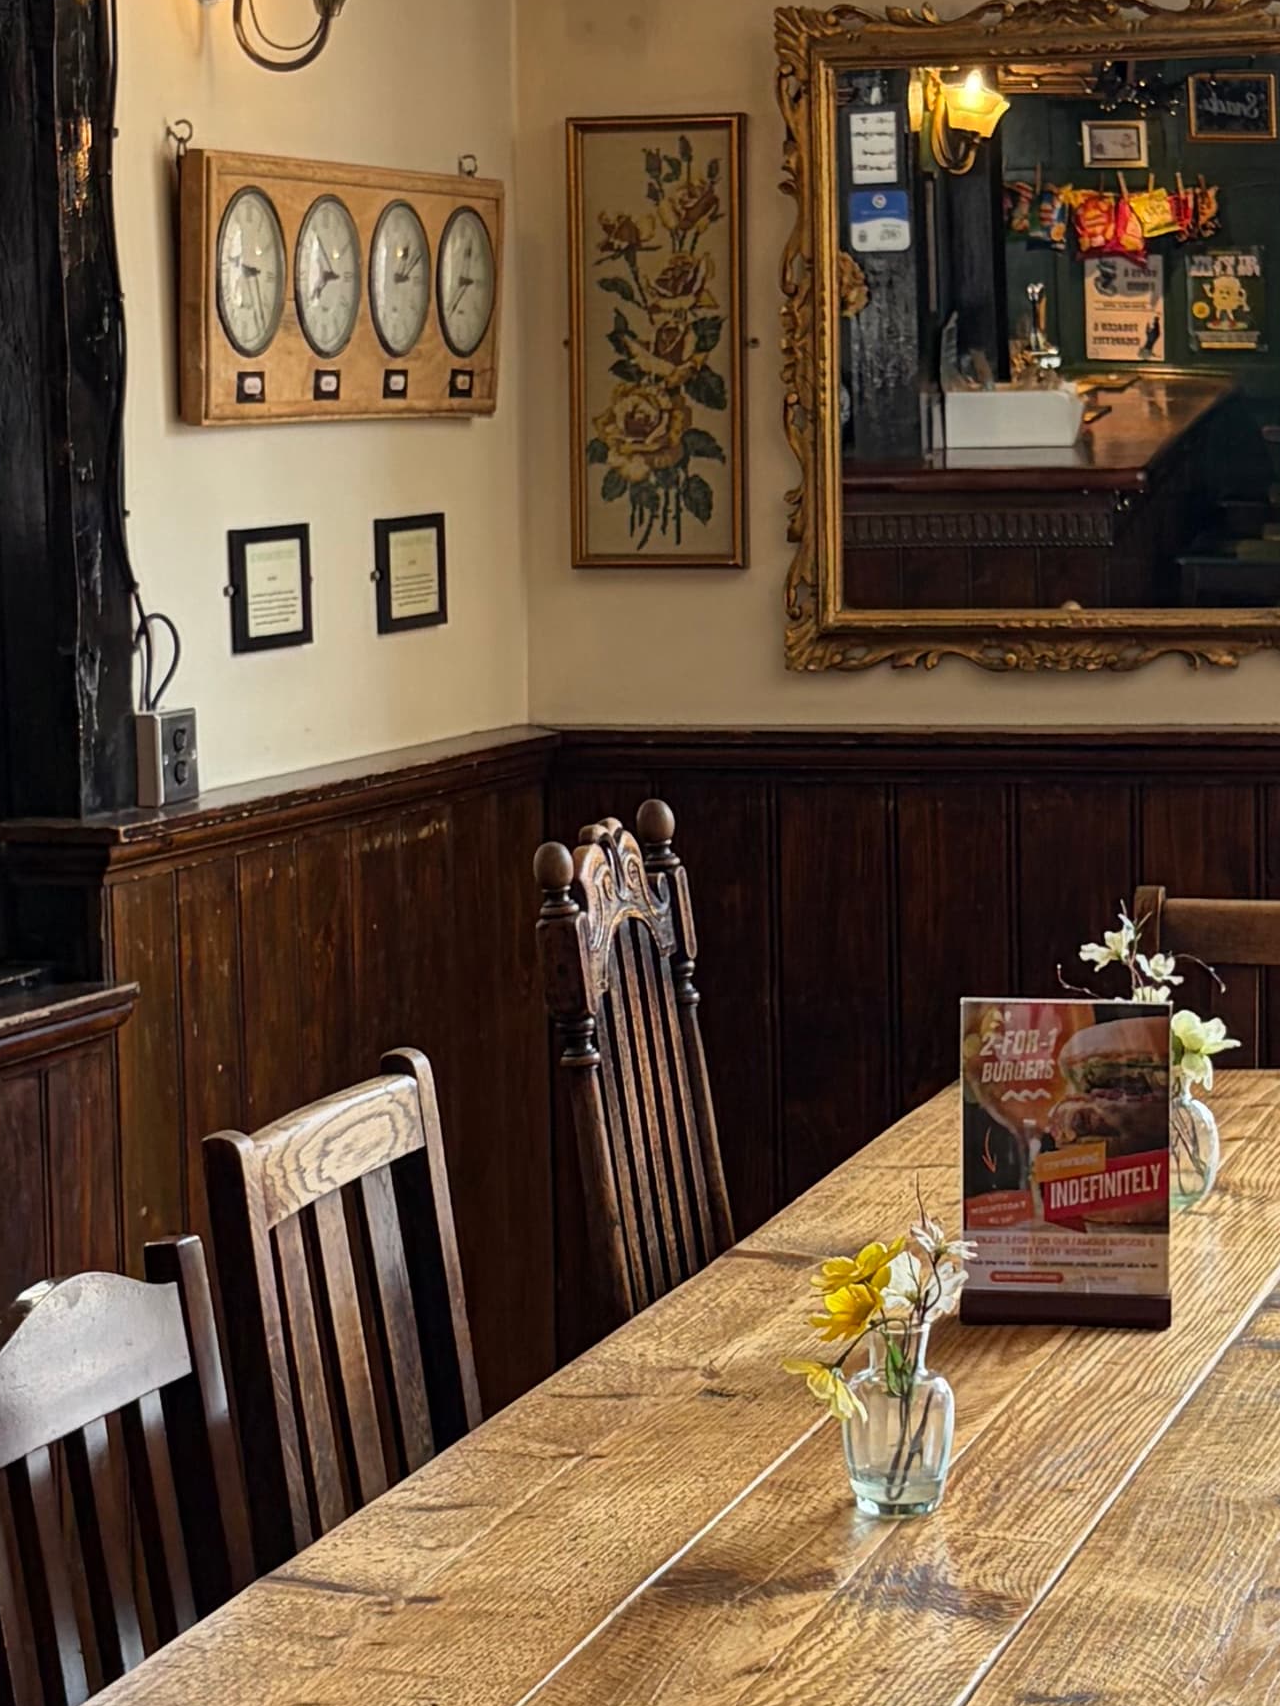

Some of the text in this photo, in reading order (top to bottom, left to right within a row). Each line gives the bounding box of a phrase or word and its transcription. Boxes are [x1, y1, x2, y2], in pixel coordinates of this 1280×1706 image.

[979, 1027, 1059, 1057] 2-FOR-1
[981, 1059, 1056, 1084] BURGERS
[1049, 1162, 1162, 1210] INDEFINITELY
